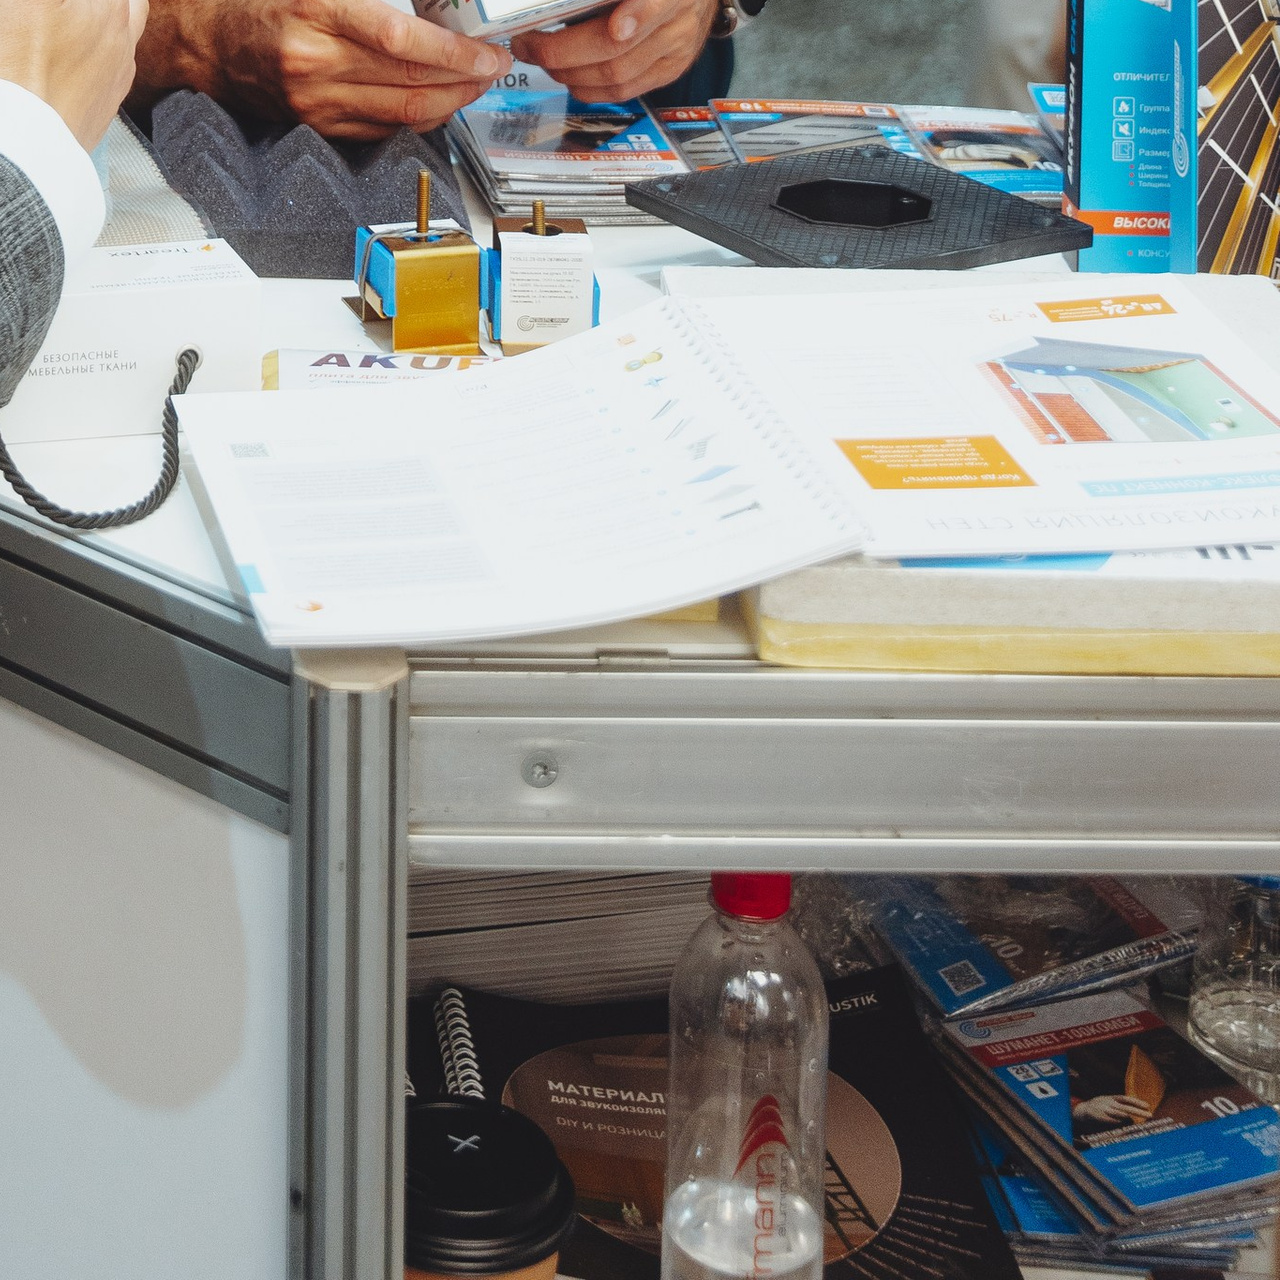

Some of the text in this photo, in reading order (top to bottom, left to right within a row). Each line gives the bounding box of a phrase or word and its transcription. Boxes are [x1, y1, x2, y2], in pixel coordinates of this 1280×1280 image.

[1139, 104, 1170, 114] Группа
[1113, 217, 1170, 229] ВЫСОК
[108, 246, 190, 259] Treartex
[43, 350, 119, 363] БЕЗОПАСНЫЕ
[28, 361, 137, 377] МЕБЕЛЬНЫЕ ТКАНИ
[902, 473, 1020, 484] Когда применять?
[925, 516, 1015, 531] СТЕН
[985, 1016, 1141, 1055] ШУМАНЕТ-100КОМБИ
[550, 1095, 577, 1106] ДЛЯ
[1200, 1096, 1242, 1119] 10
[556, 1116, 578, 1129] DIY
[582, 1121, 594, 1130] И
[753, 1152, 775, 1280] mann
